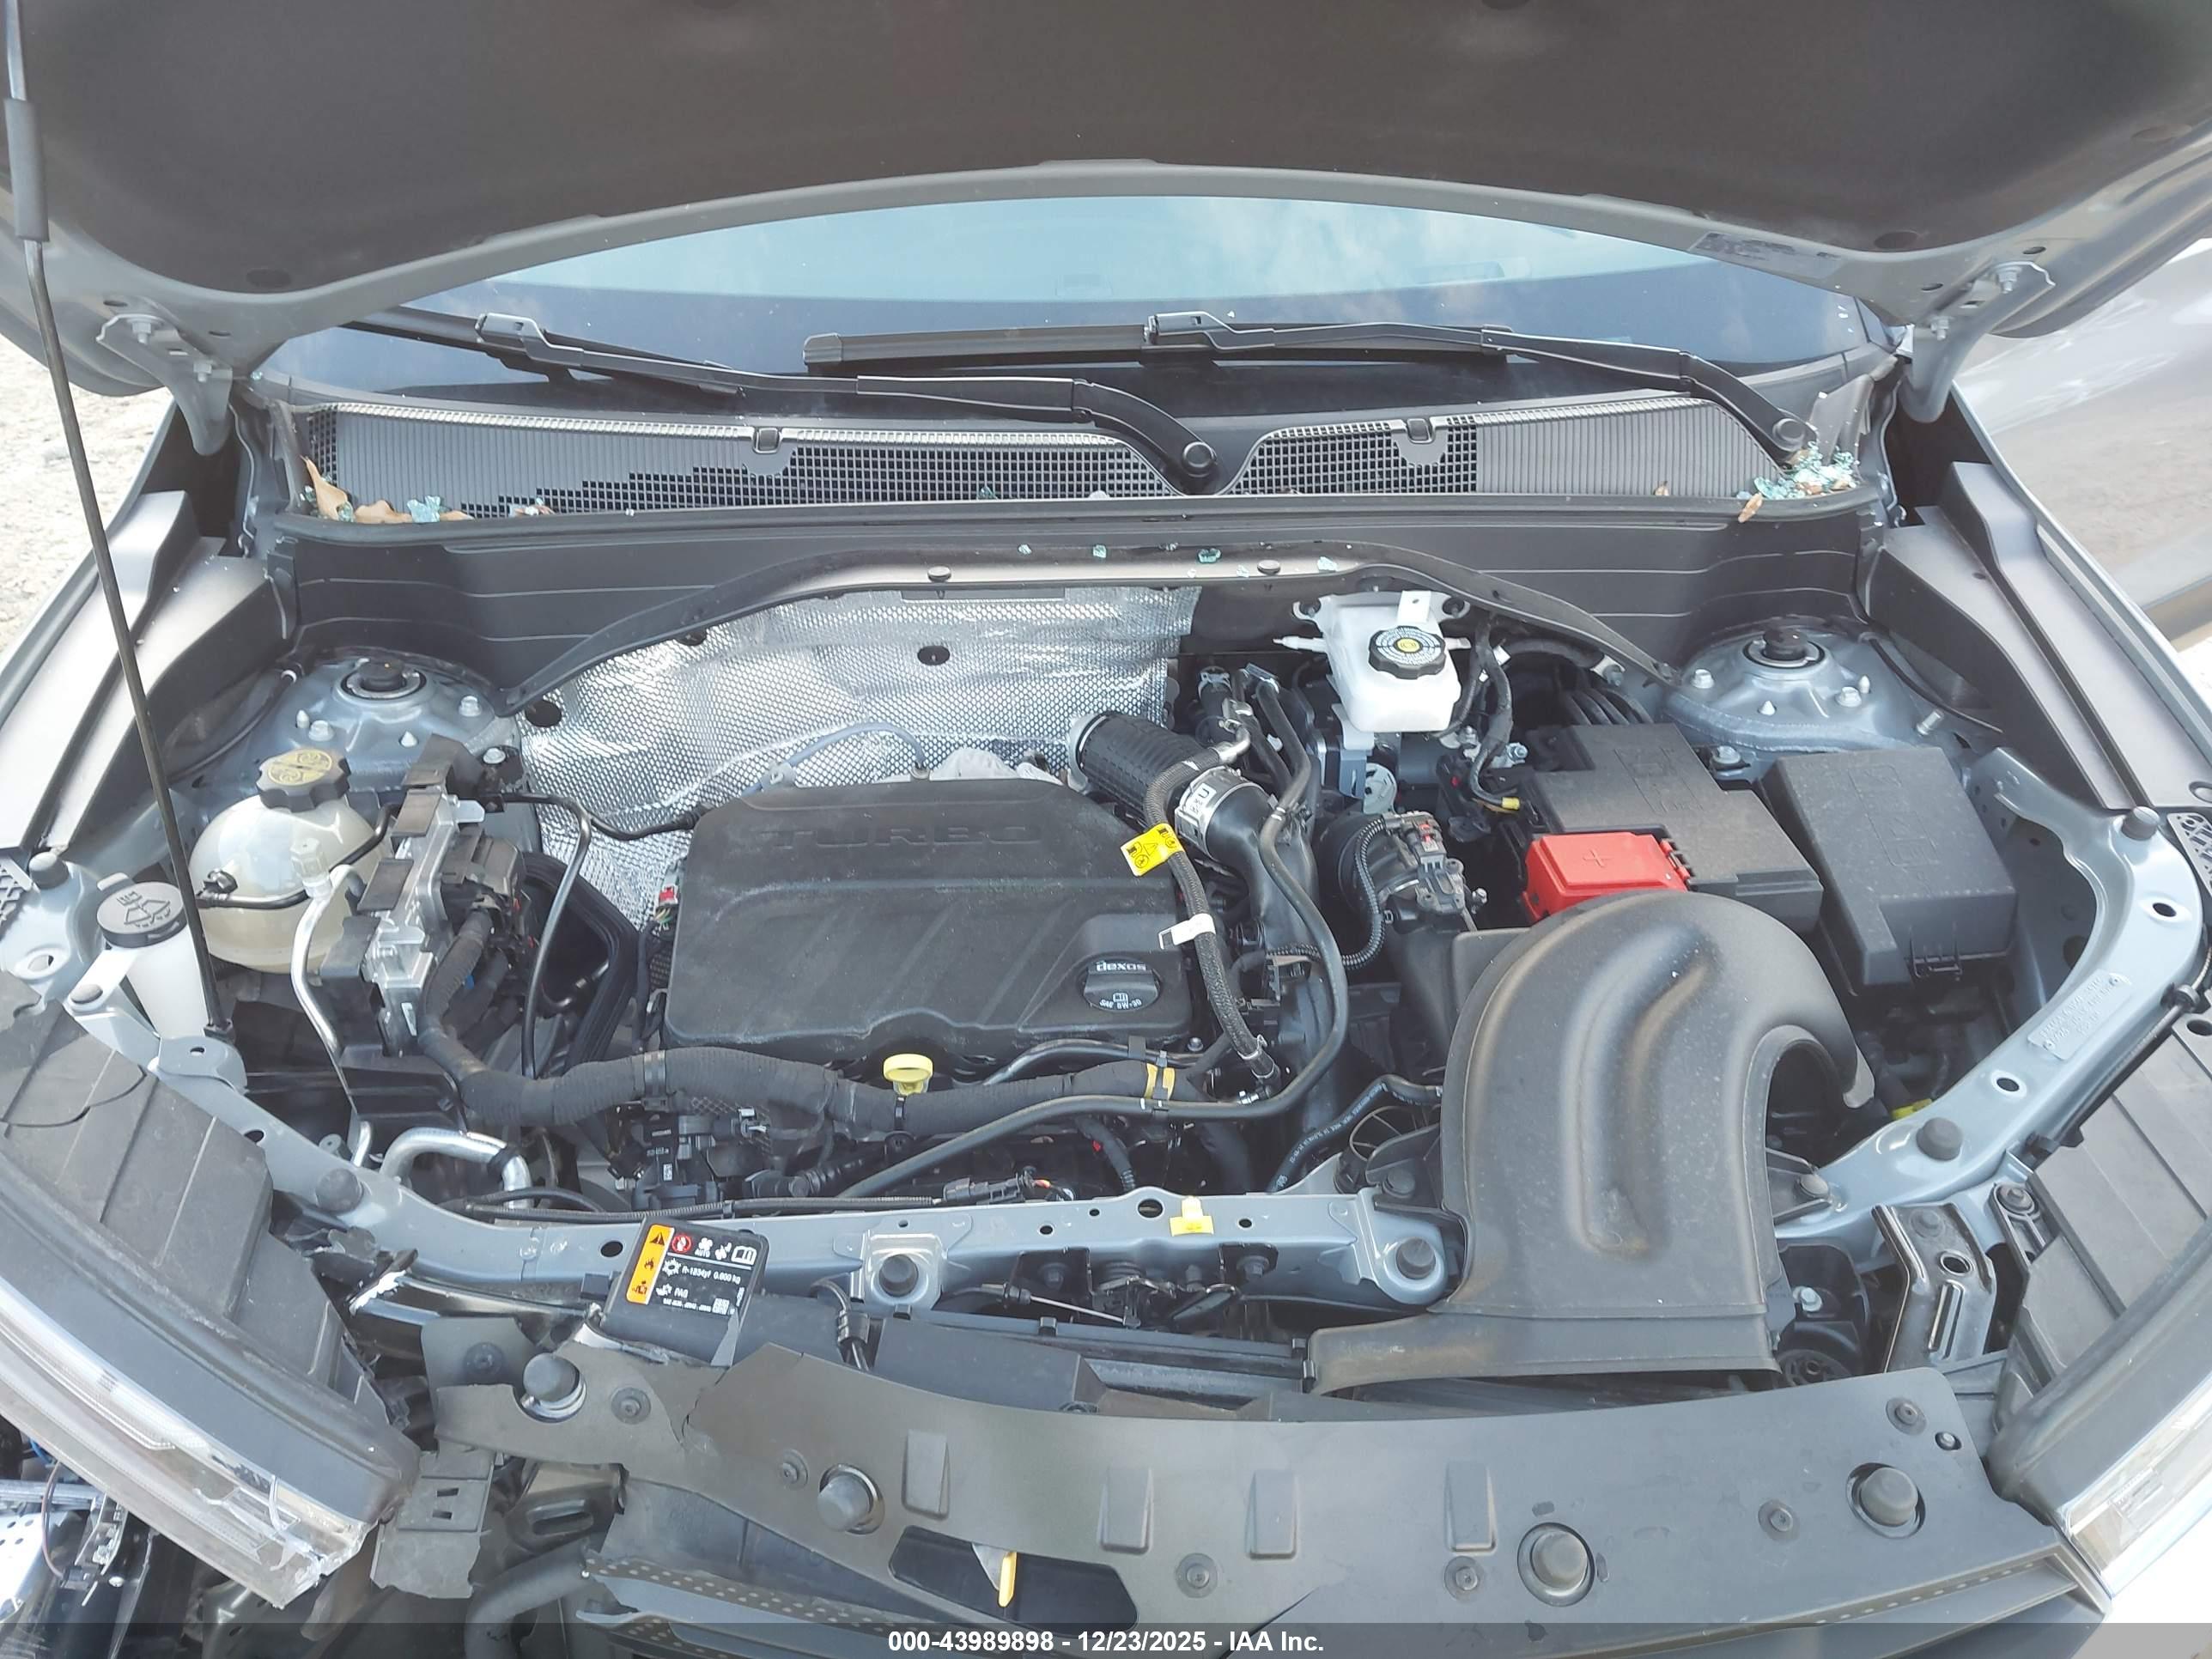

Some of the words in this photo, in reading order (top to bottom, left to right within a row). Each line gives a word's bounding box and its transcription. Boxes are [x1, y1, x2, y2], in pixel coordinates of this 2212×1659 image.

[761, 824, 1043, 849] TURBO
[1097, 960, 1146, 971] dexos
[1099, 1000, 1114, 1008] SAE
[695, 1249, 710, 1258] AUTO
